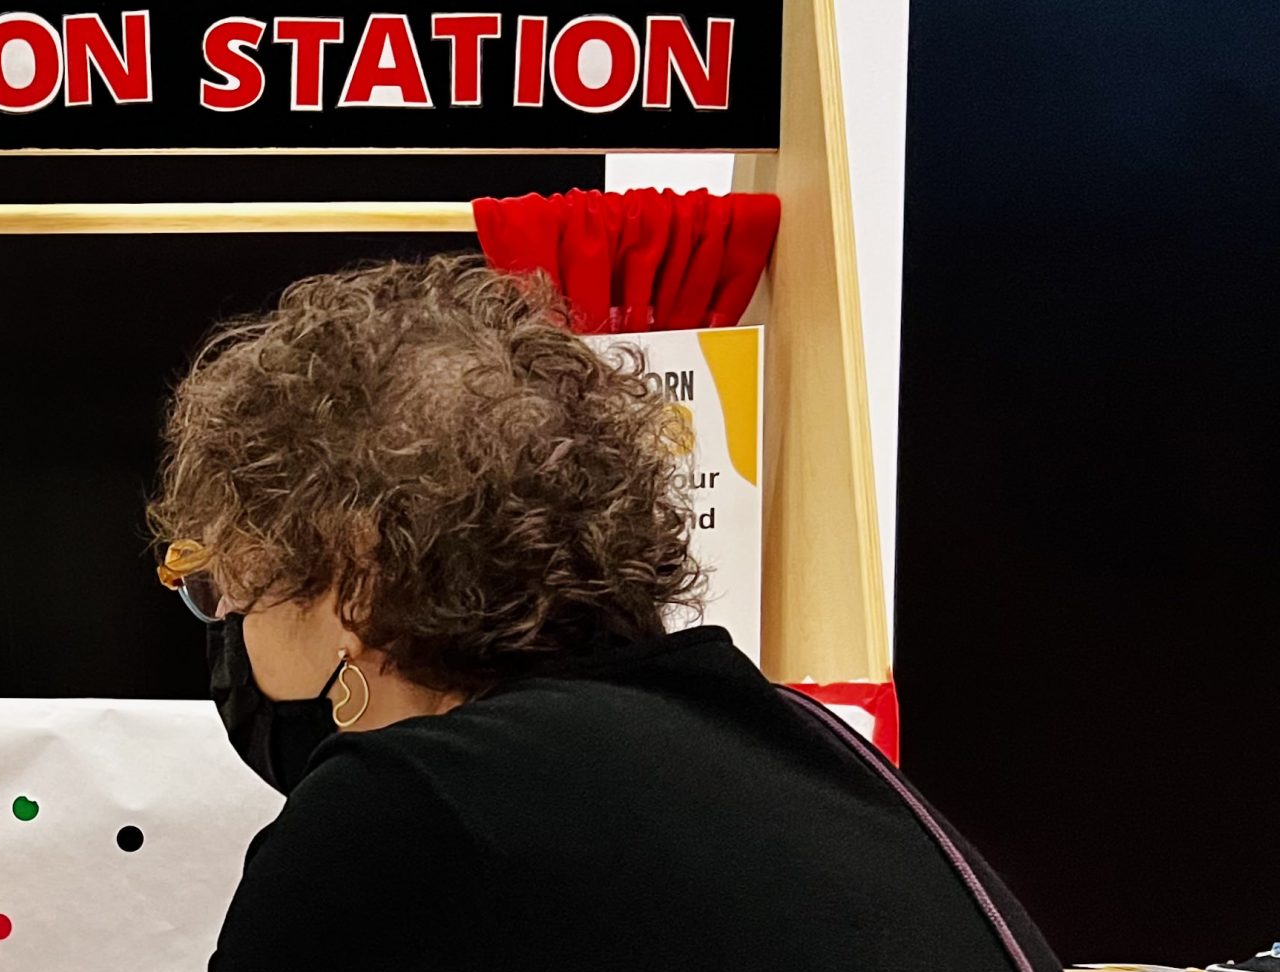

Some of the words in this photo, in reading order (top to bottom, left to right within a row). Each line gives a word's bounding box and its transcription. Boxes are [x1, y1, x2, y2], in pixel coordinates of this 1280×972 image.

[200, 13, 734, 112] STATION
[645, 371, 694, 402] ORN
[671, 471, 719, 489] our
